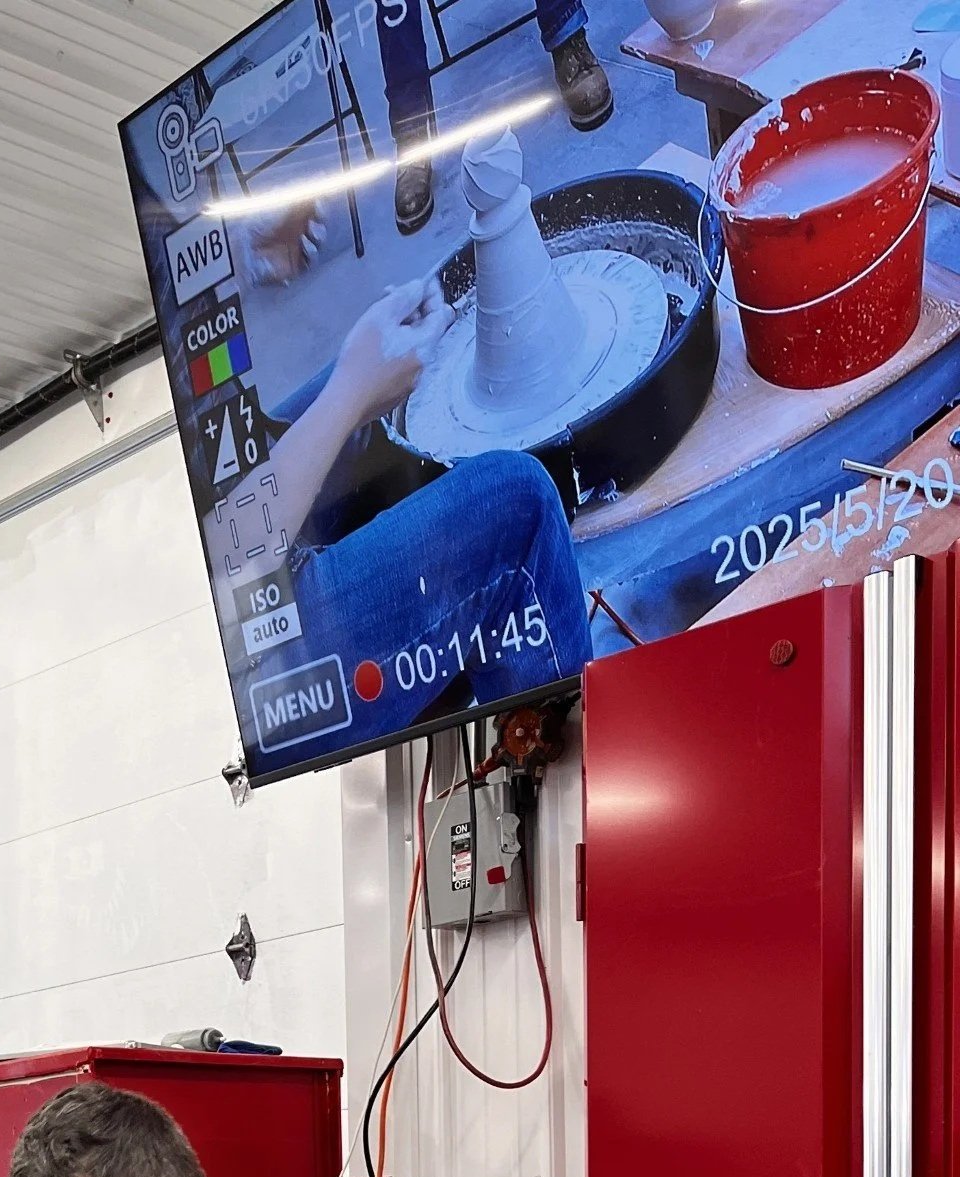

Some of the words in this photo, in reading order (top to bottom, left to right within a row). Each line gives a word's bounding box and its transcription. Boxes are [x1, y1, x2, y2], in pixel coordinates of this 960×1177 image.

[177, 229, 223, 283] AWB
[187, 306, 240, 351] COLOR
[711, 458, 954, 584] 2025/5/20
[249, 583, 280, 613] ISO
[253, 613, 289, 643] auto
[395, 604, 547, 690] 00:11:45
[263, 679, 334, 729] MENU
[455, 825, 468, 834] ON
[454, 879, 470, 890] OFF
